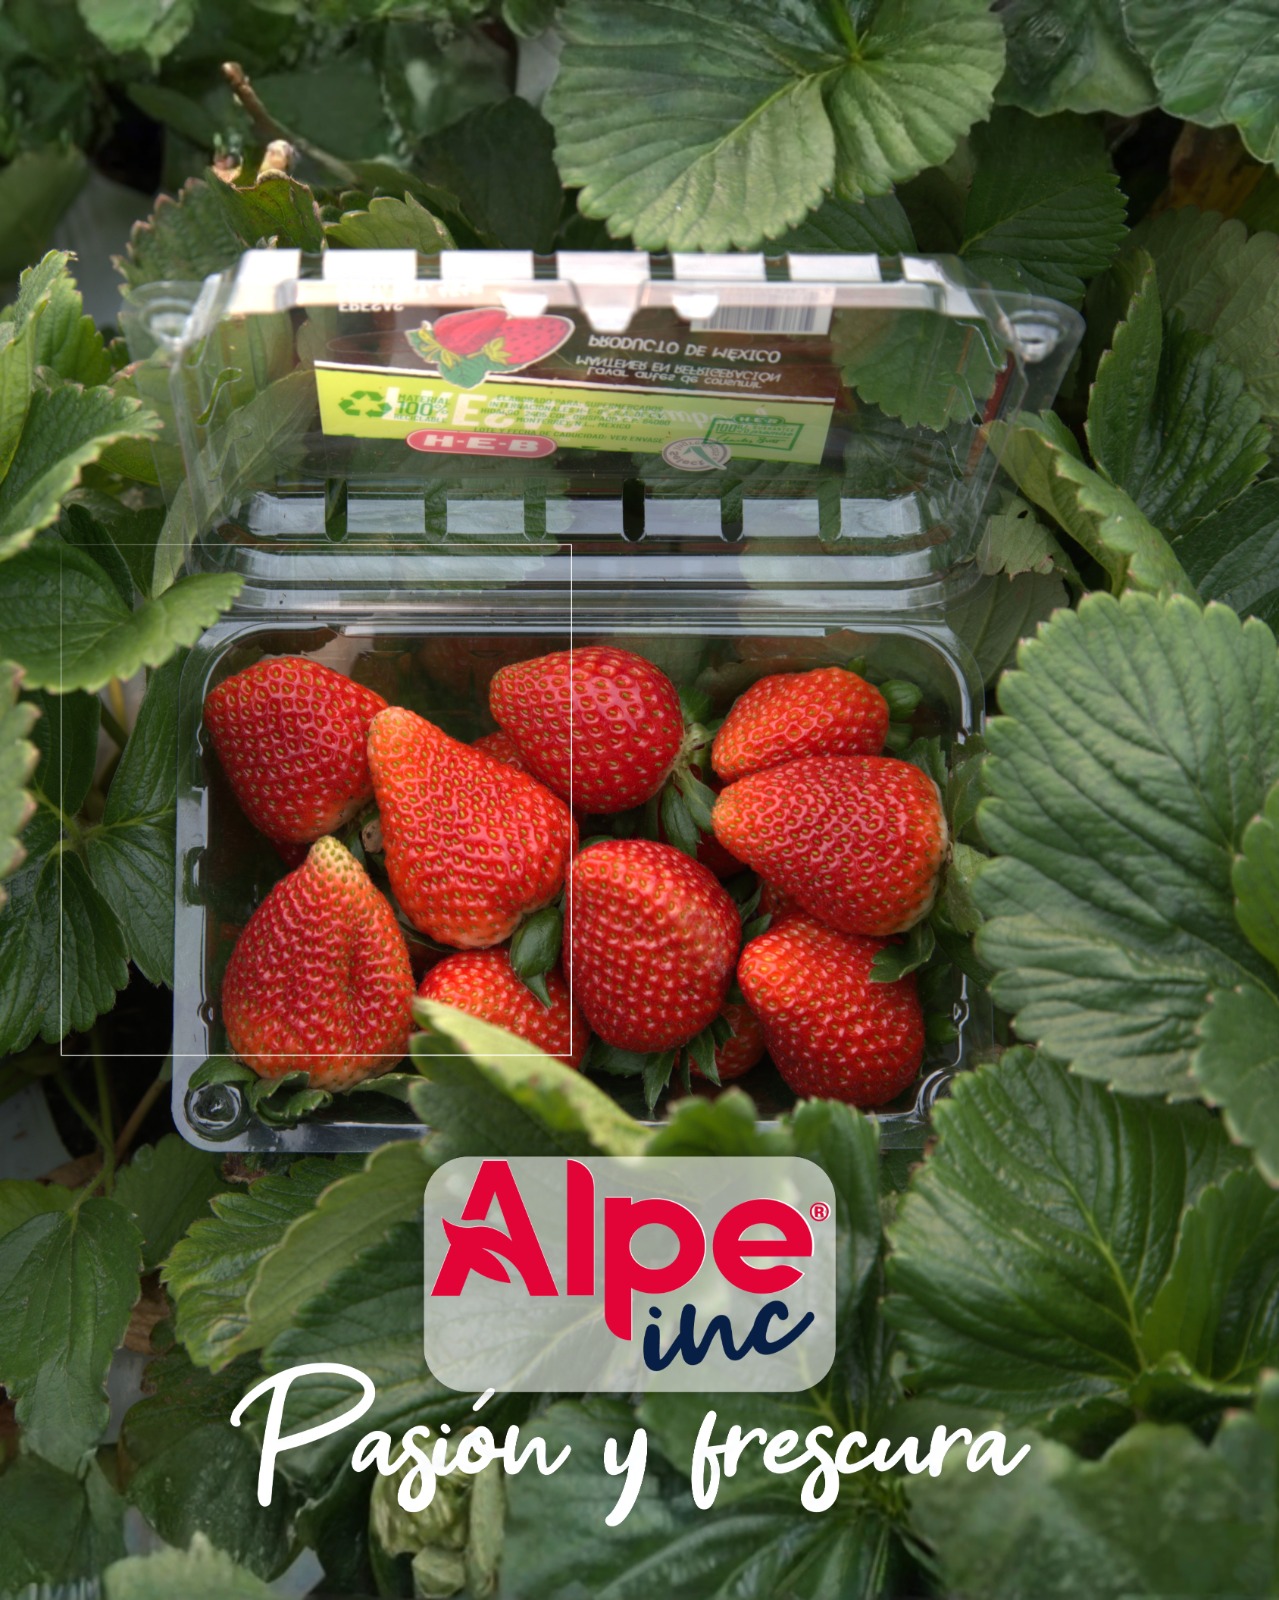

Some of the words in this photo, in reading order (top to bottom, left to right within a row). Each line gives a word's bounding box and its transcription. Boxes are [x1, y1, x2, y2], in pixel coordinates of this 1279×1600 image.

[398, 394, 450, 406] MATERIAL
[398, 401, 449, 416] 100%
[422, 434, 540, 452] H-E-B
